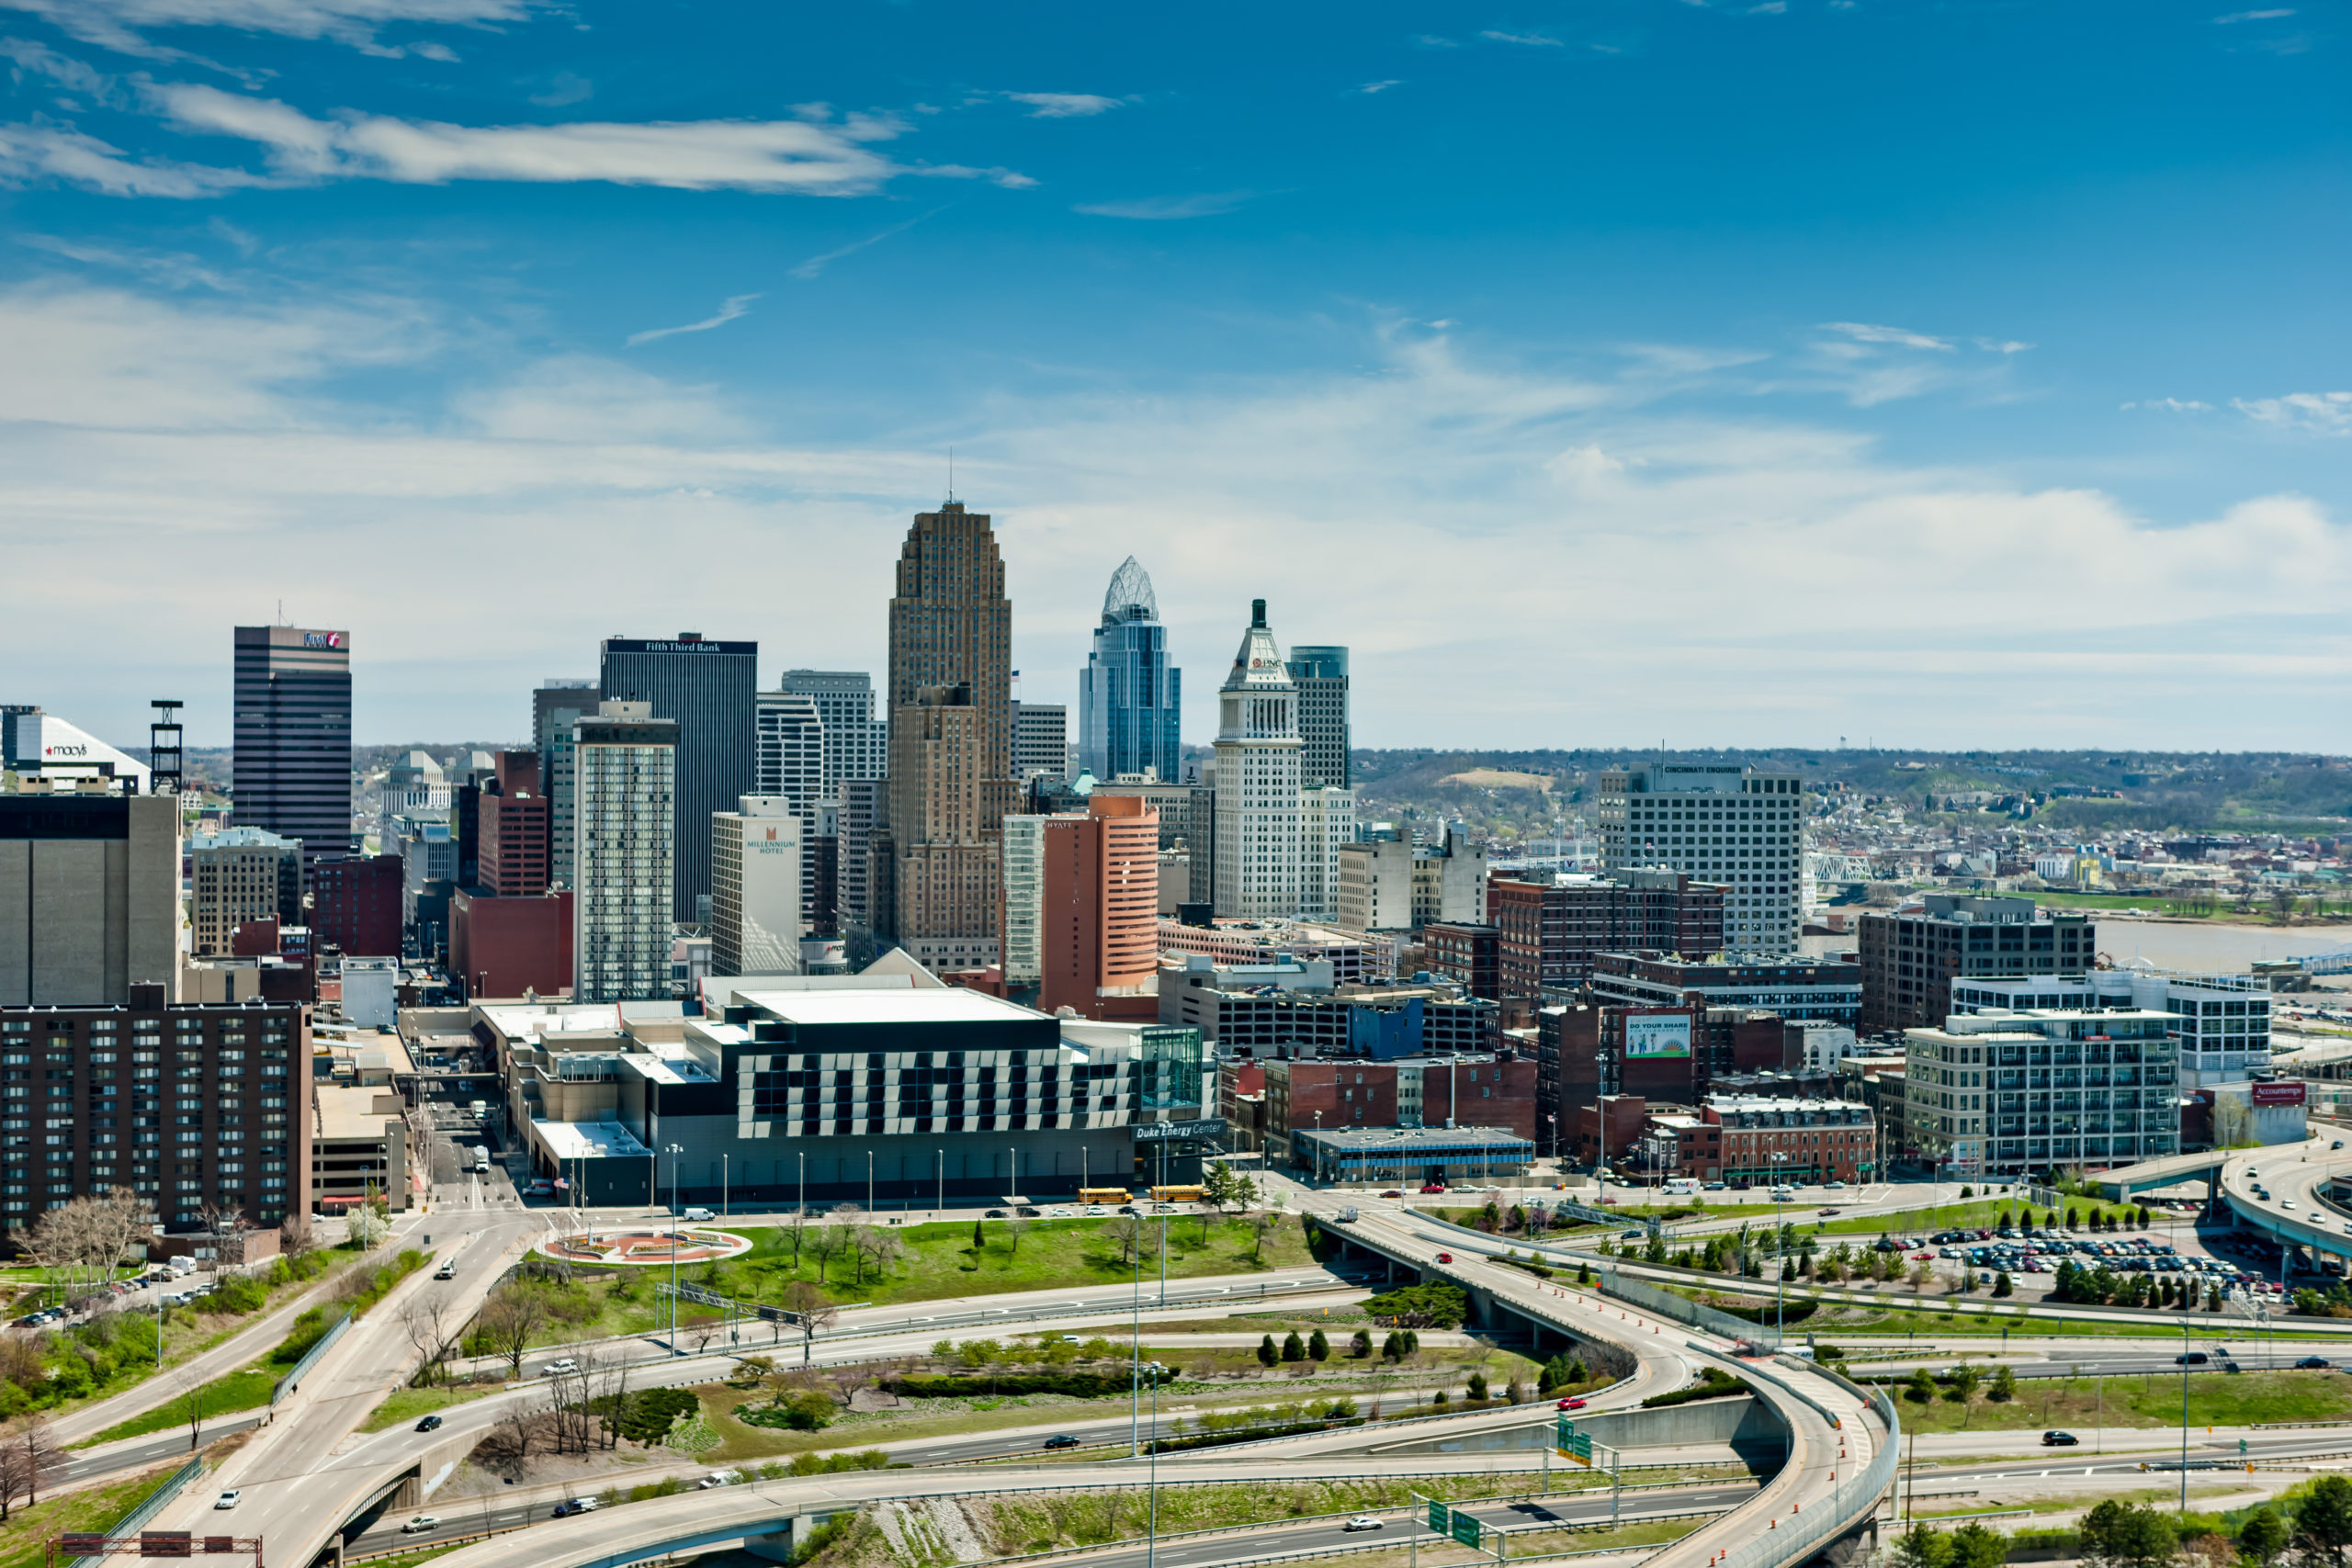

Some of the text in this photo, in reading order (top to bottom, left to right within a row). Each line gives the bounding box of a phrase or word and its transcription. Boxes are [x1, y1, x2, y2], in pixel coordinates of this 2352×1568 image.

[304, 632, 327, 647] First
[646, 642, 720, 652] Fifth Third Bank
[2256, 1087, 2302, 1097] Accountemps
[1136, 1123, 1221, 1138] Duke Energy Center
